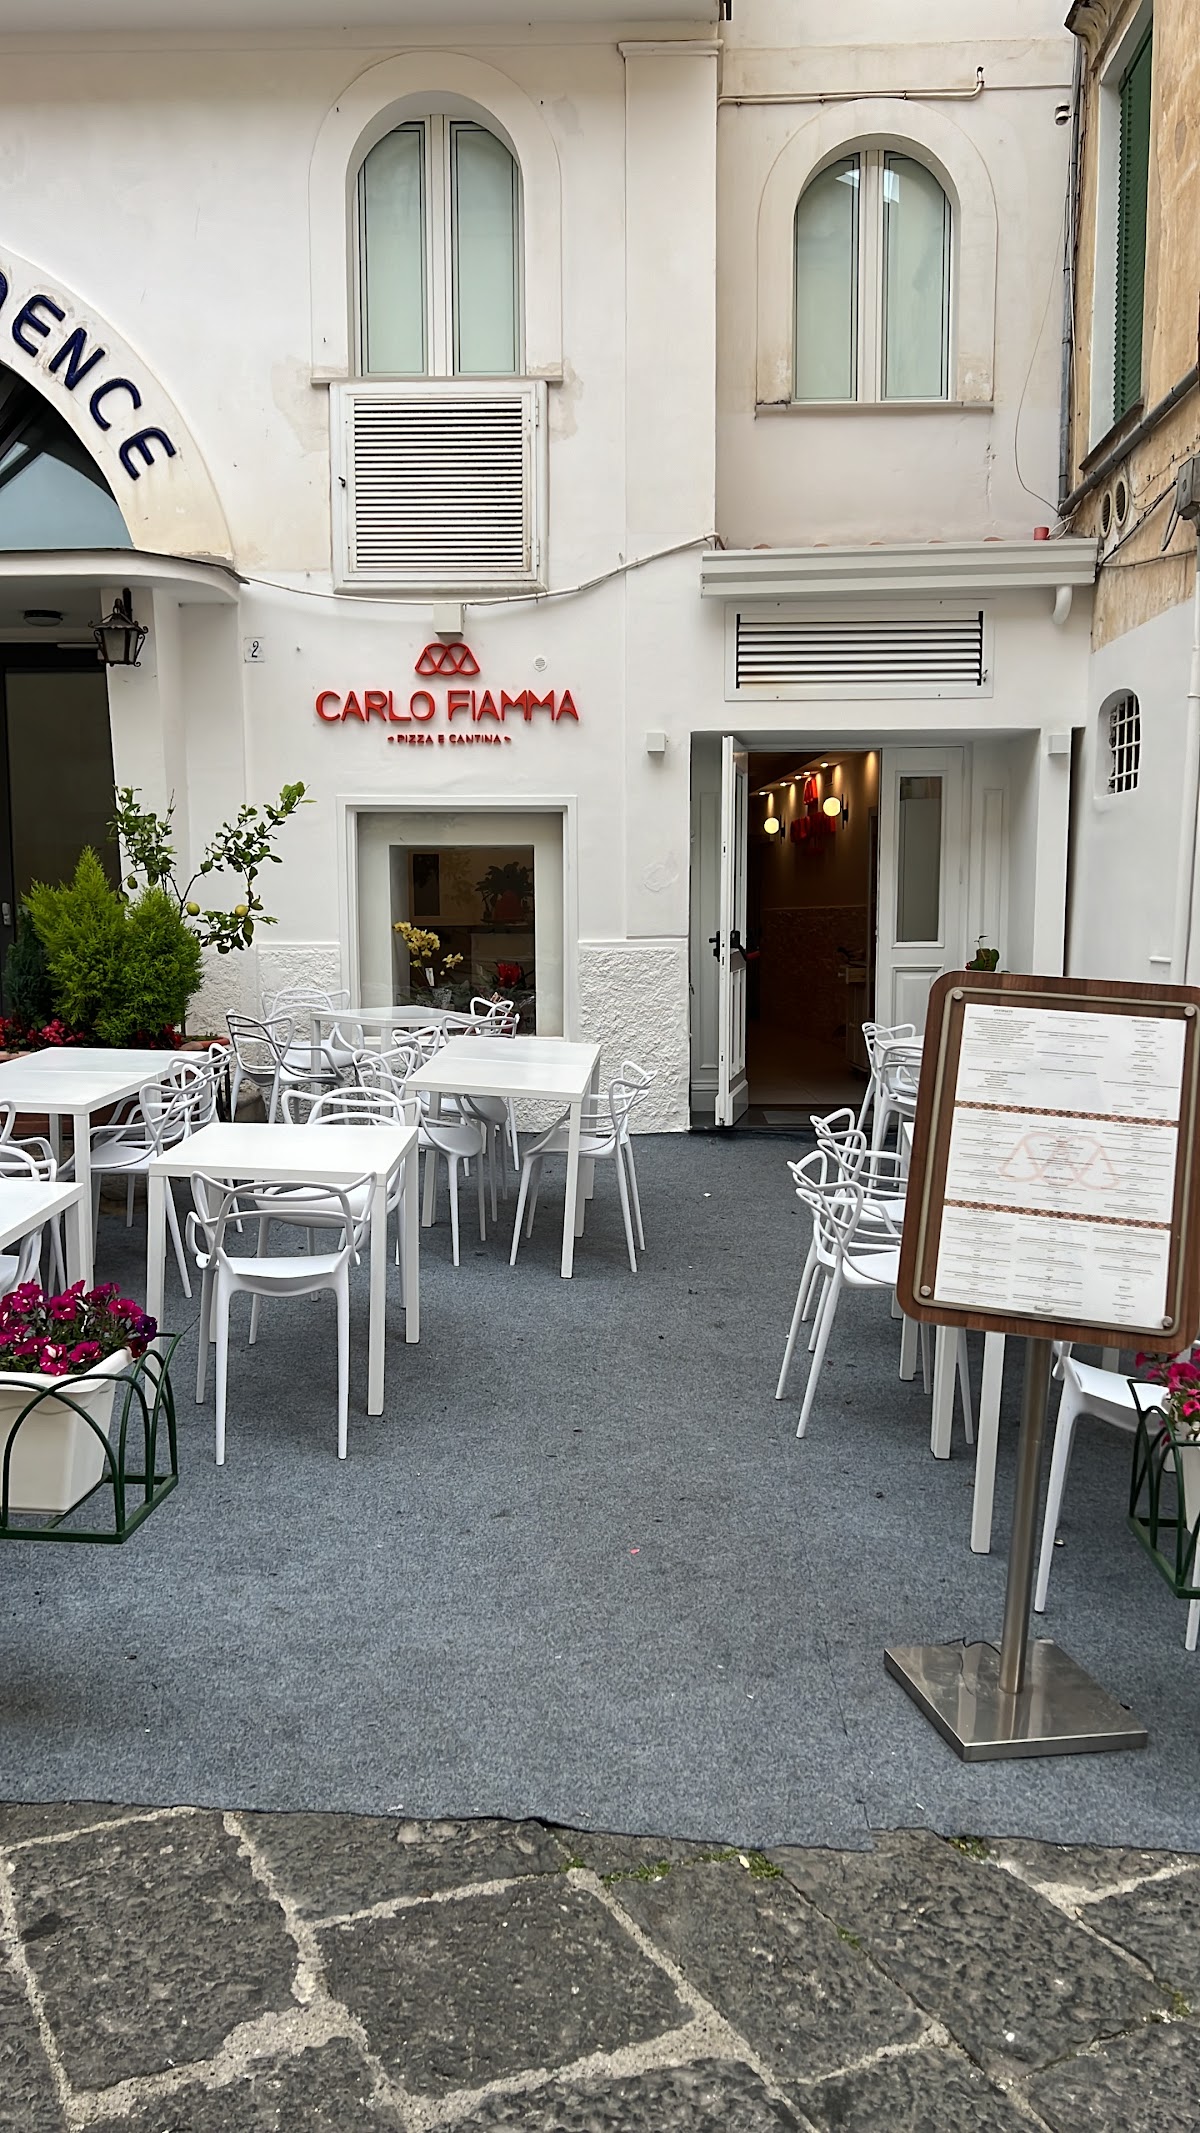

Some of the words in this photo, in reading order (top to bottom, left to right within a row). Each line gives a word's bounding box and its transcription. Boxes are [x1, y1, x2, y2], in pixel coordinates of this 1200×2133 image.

[251, 640, 259, 658] 2
[315, 690, 436, 721] CARLO
[447, 689, 579, 721] FIAMMA
[397, 734, 433, 744] PIZZA
[438, 734, 445, 744] E
[449, 734, 502, 744] CANTINA
